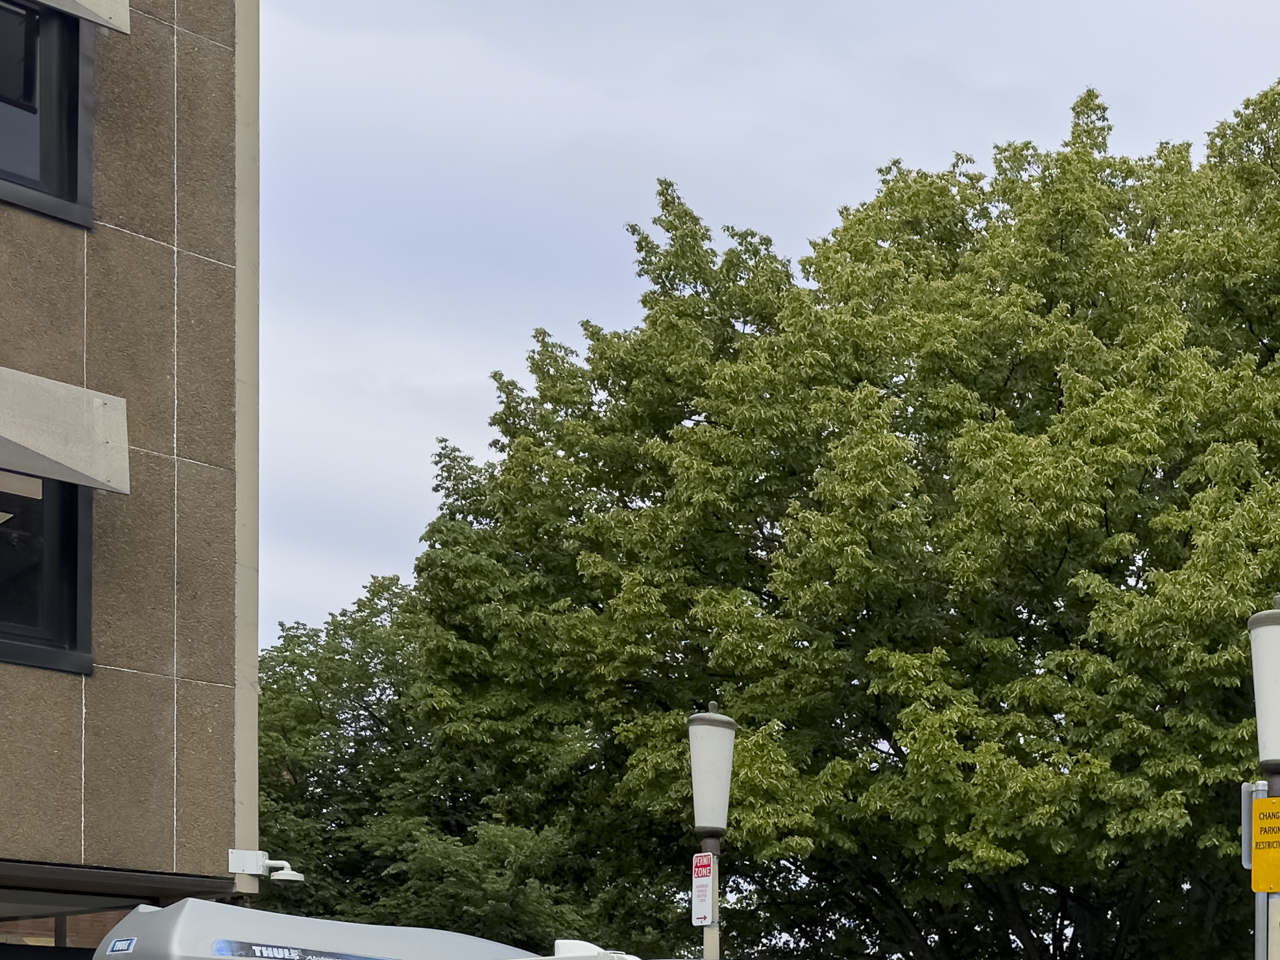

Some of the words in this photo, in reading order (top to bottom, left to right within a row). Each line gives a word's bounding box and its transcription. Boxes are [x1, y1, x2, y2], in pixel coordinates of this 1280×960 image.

[694, 856, 711, 866] PERMIT
[694, 867, 711, 878] ZONE
[251, 945, 300, 960] THULE
